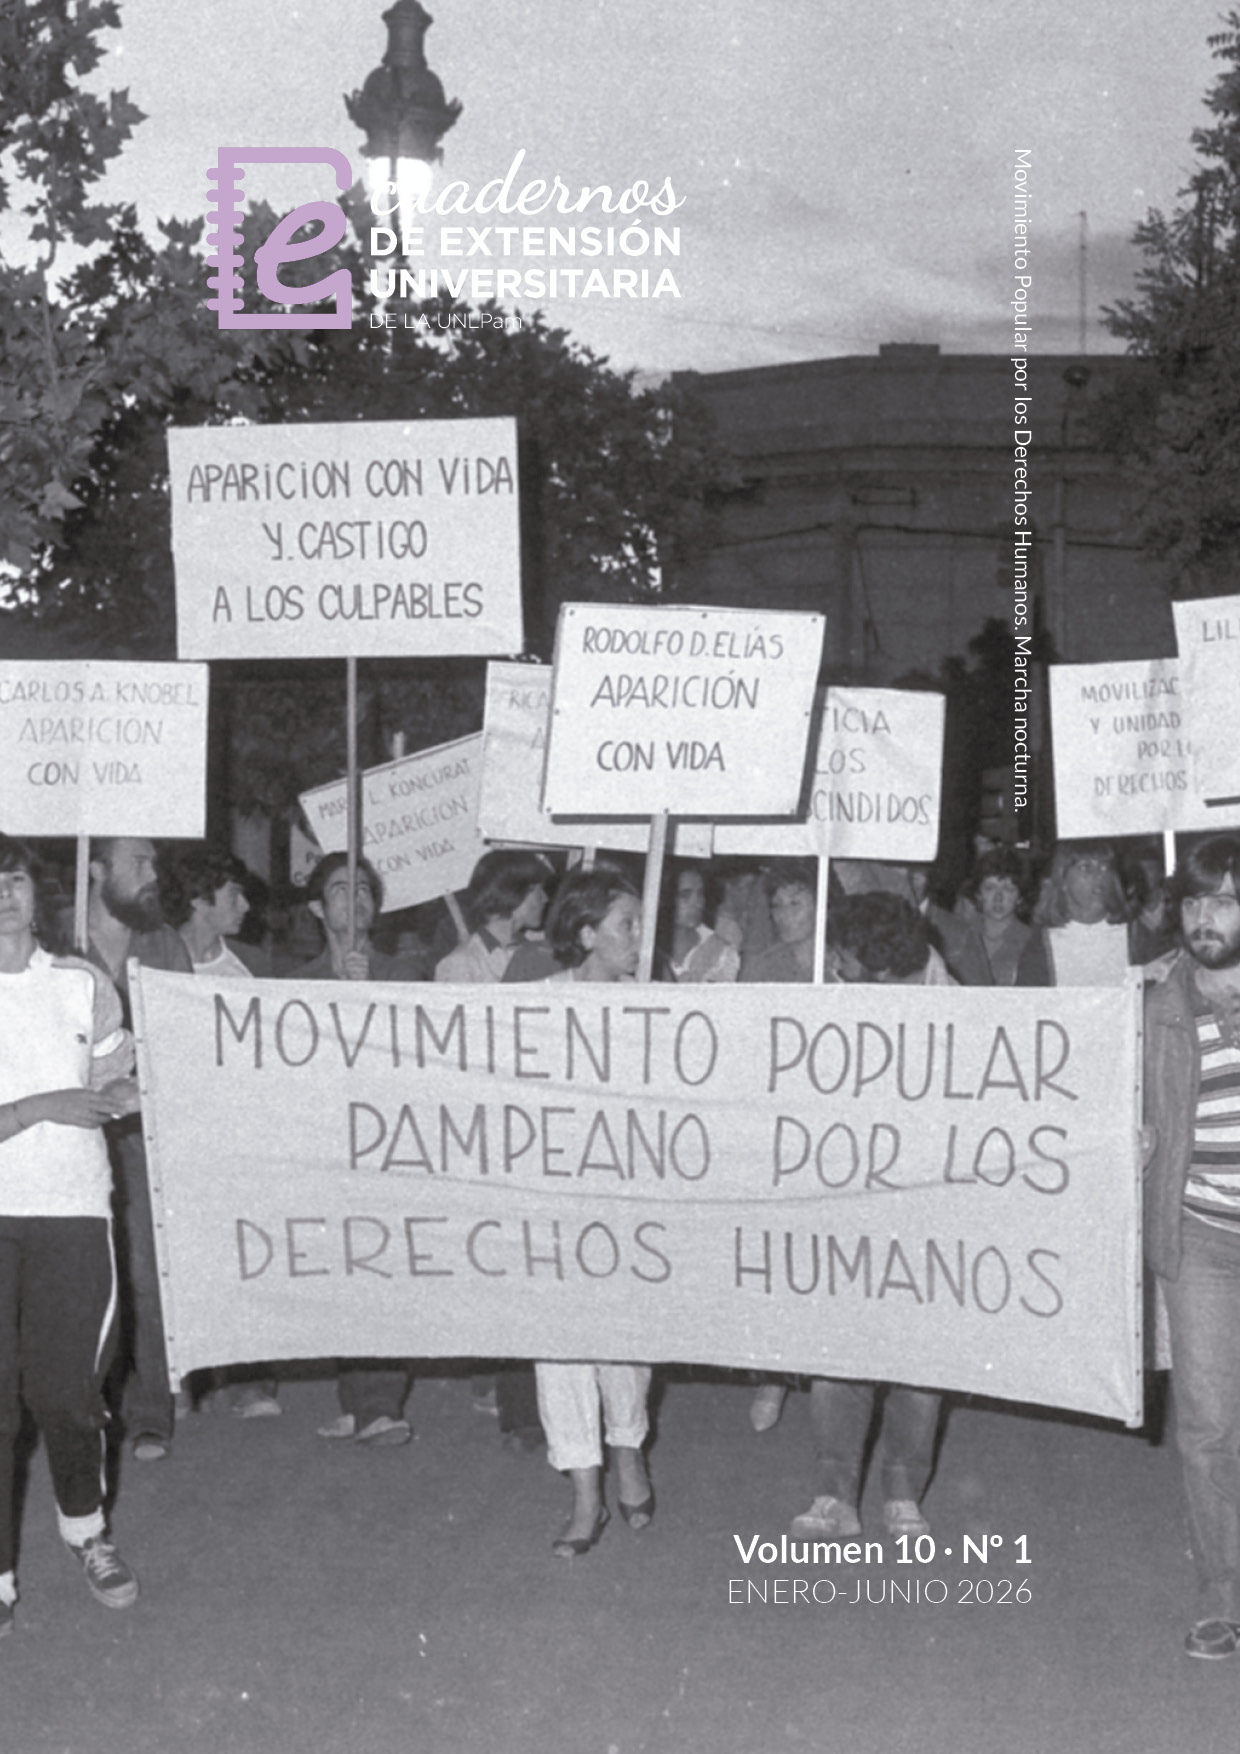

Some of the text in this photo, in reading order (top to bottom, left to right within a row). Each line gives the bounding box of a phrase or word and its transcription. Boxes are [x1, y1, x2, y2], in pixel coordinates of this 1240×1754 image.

[366, 458, 423, 498] CON
[298, 519, 428, 561] CASTIGO
[212, 582, 484, 623] A LOS CULPABLES
[582, 626, 684, 656] RODOLFO
[1202, 618, 1240, 642] LIL
[116, 681, 200, 707] KNOBEL
[589, 670, 760, 710] APARICIÓN
[17, 717, 164, 745] APARICION
[824, 706, 891, 735] ICIA
[1089, 711, 1182, 736] Y UNIDAD
[597, 740, 727, 773] CON VIDA
[27, 761, 143, 786] CON VIDA
[808, 789, 933, 826] CINDIDOS
[414, 838, 456, 861] VIDA
[213, 993, 1079, 1102] MOVIMIENTO POPULAR
[349, 1101, 1071, 1195] PAMPEANO POR LOS
[235, 1215, 1064, 1318] DERECHOS HUMANOS
